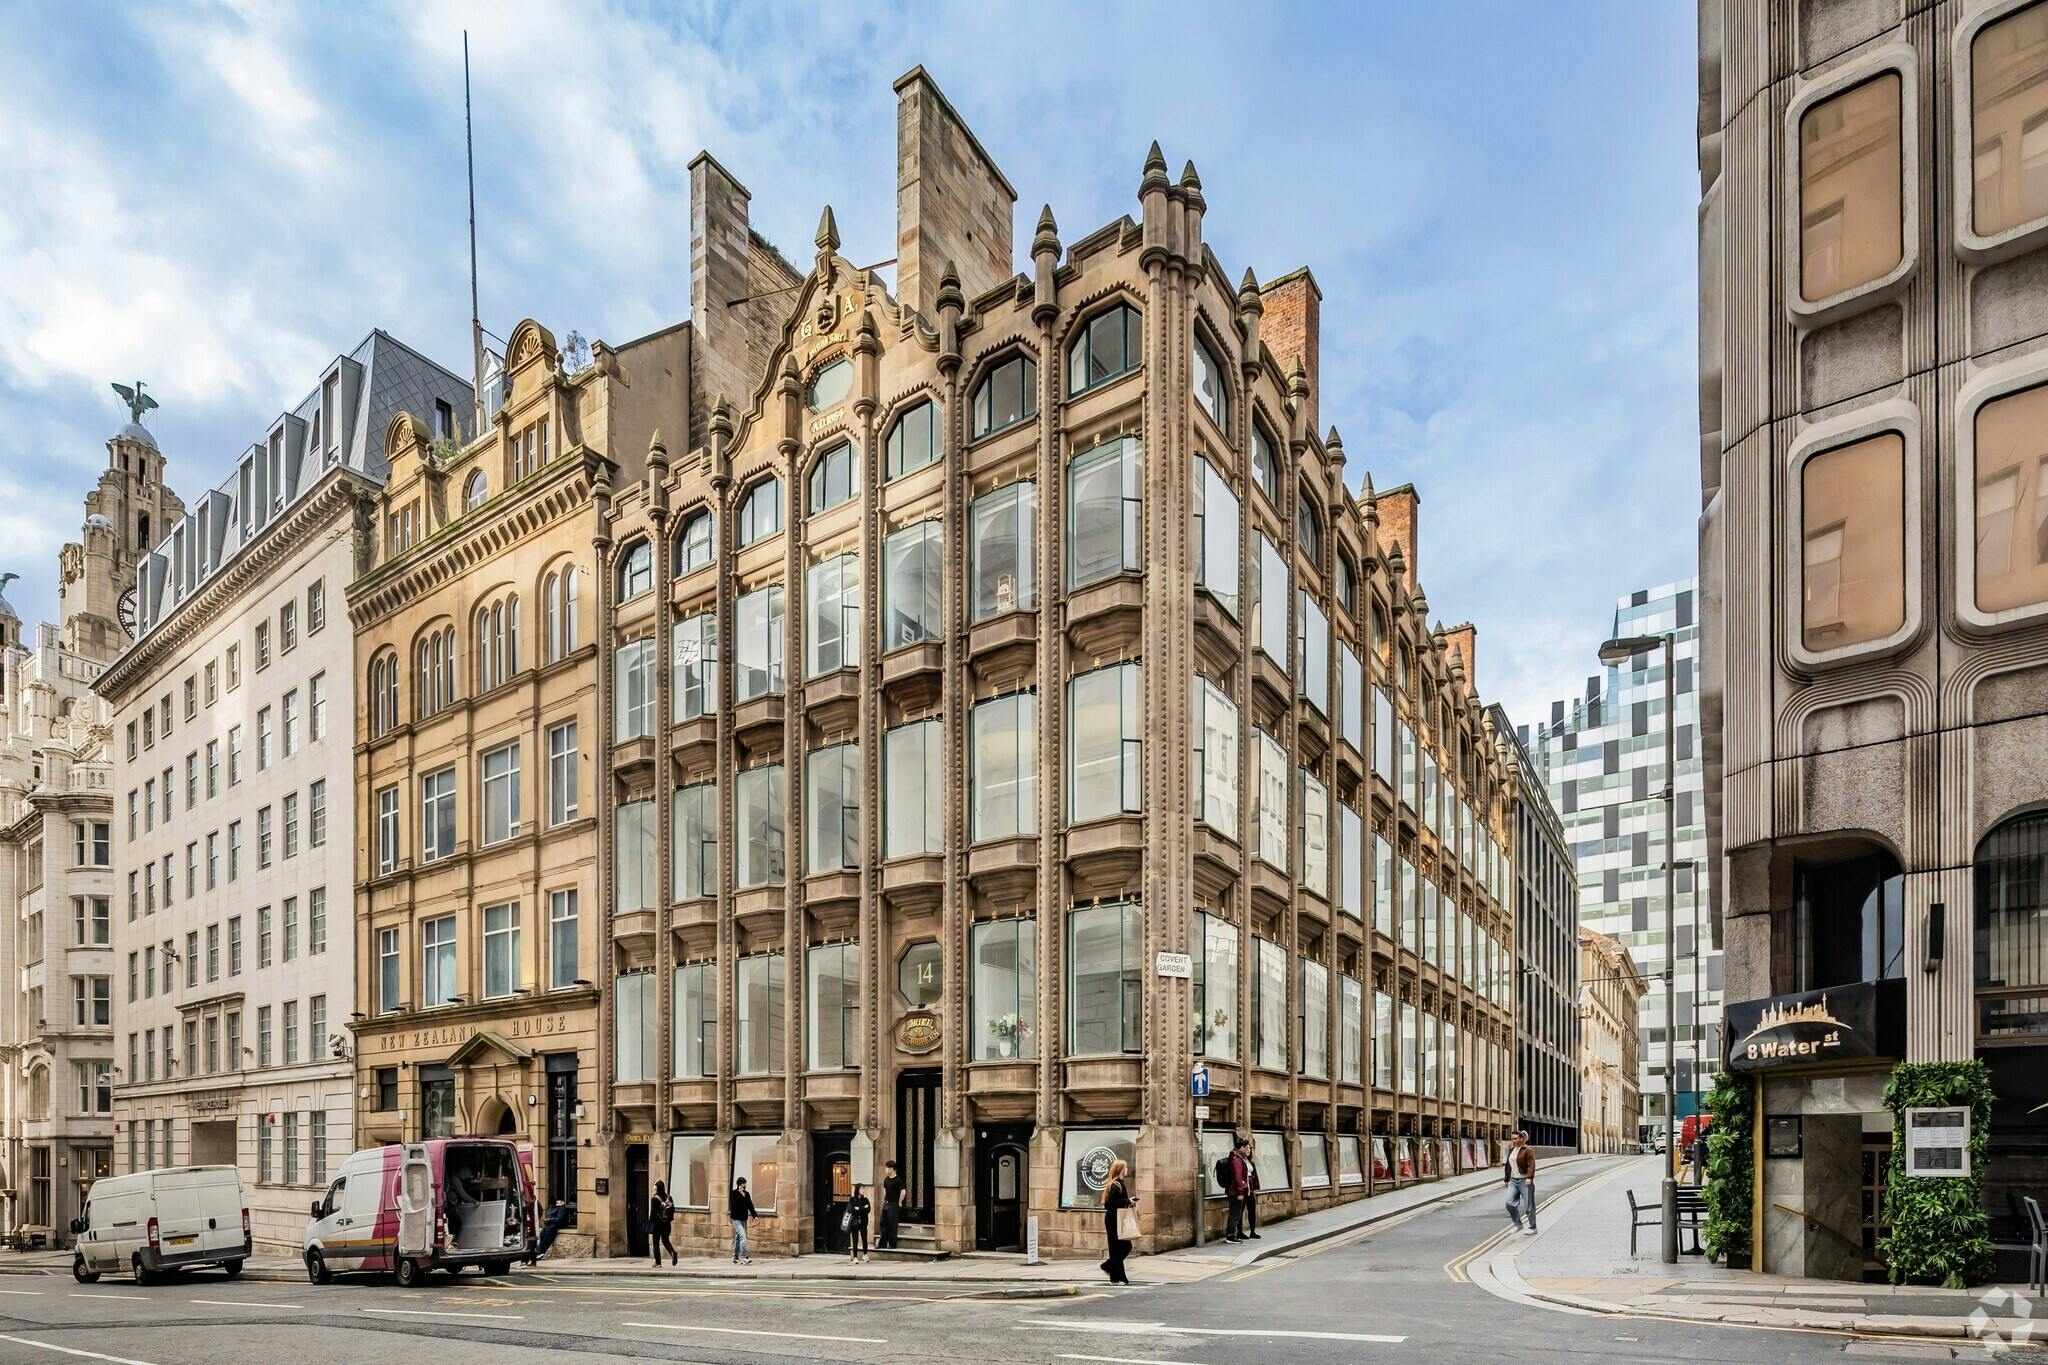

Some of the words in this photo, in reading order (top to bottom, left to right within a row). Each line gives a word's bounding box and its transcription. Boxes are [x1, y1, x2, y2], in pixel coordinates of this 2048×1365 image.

[1158, 963, 1185, 973] GARDEN
[1160, 954, 1187, 964] COVENT
[917, 962, 933, 984] 14
[380, 1034, 405, 1051] NEW
[414, 1024, 477, 1047] ZEALAND
[512, 1015, 566, 1036] HOUSE
[1747, 1044, 1758, 1060] 8
[1760, 1039, 1820, 1059] Water
[1824, 1030, 1839, 1042] st
